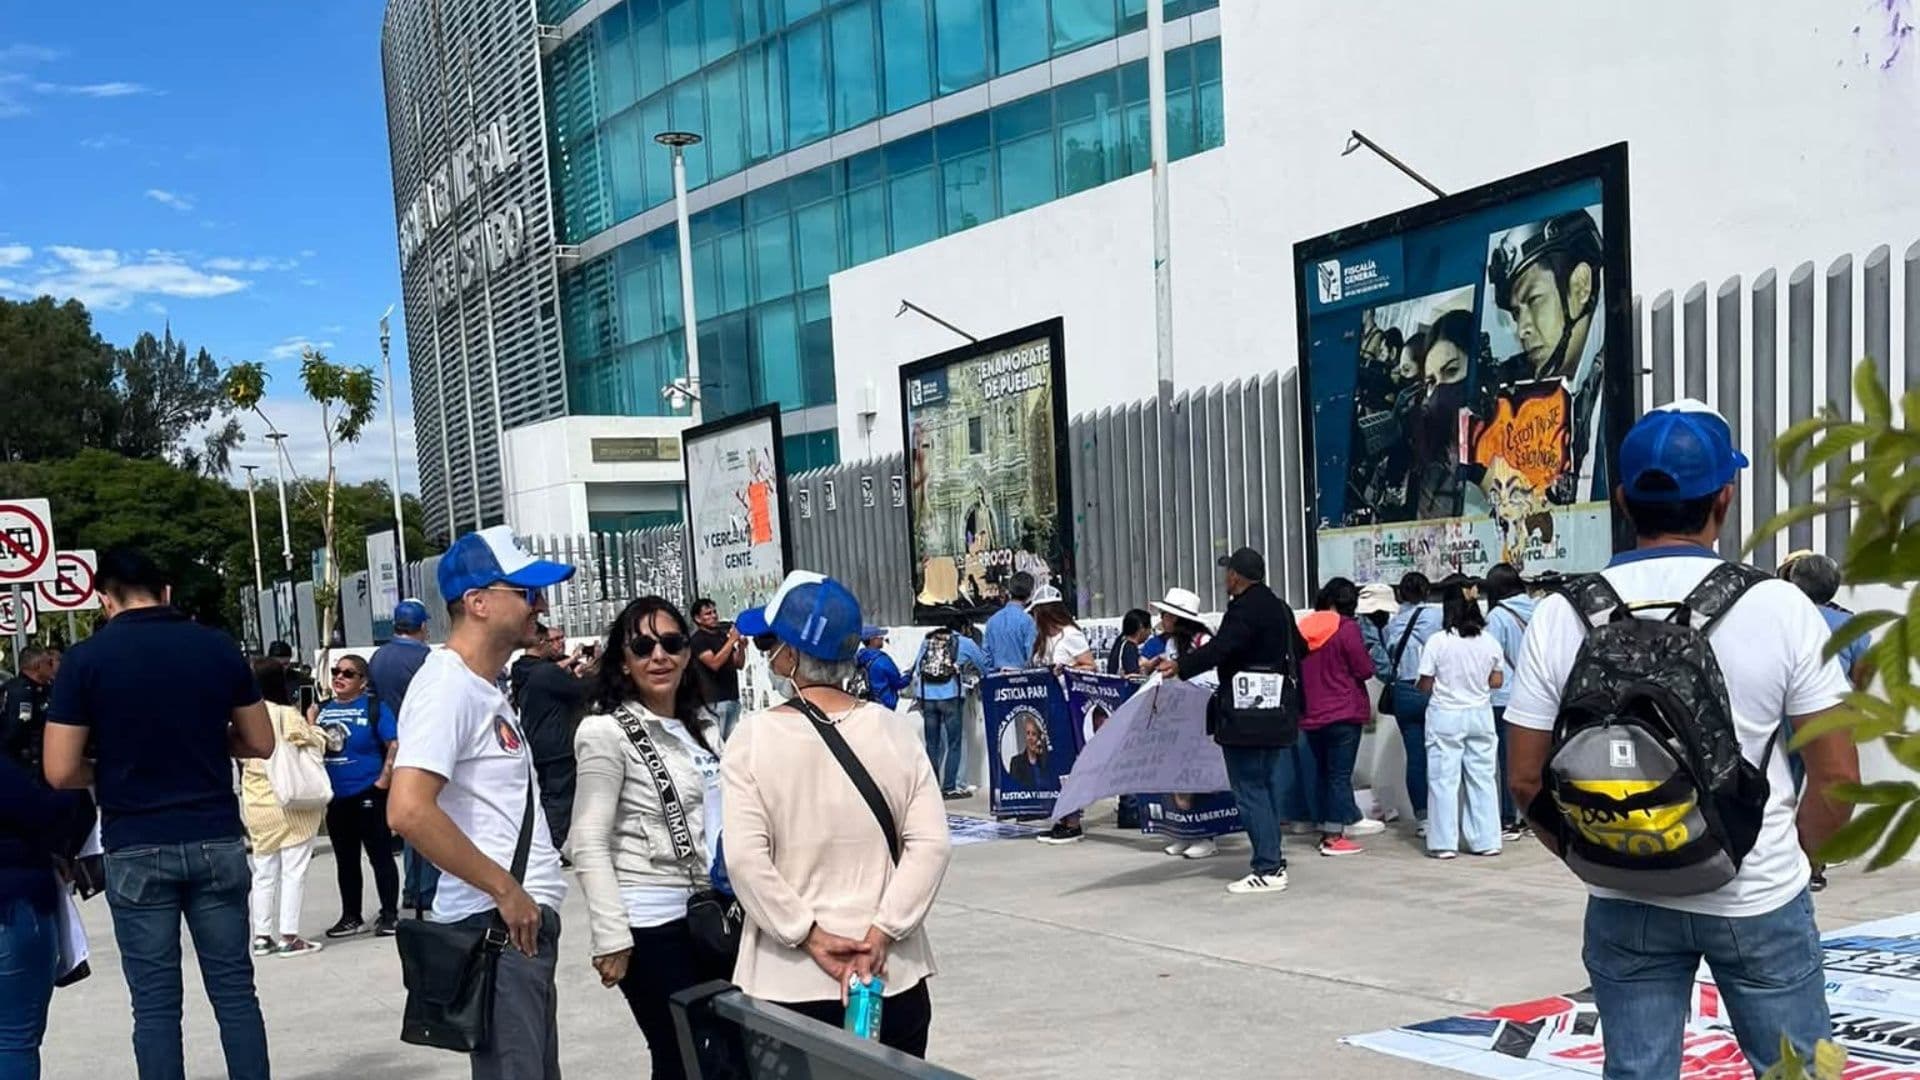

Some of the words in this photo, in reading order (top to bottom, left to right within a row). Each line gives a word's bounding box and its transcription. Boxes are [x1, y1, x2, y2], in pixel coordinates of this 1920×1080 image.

[985, 380, 1000, 400] DE
[1001, 367, 1047, 396] PUEBLA!
[665, 801, 692, 859] BIMBA
